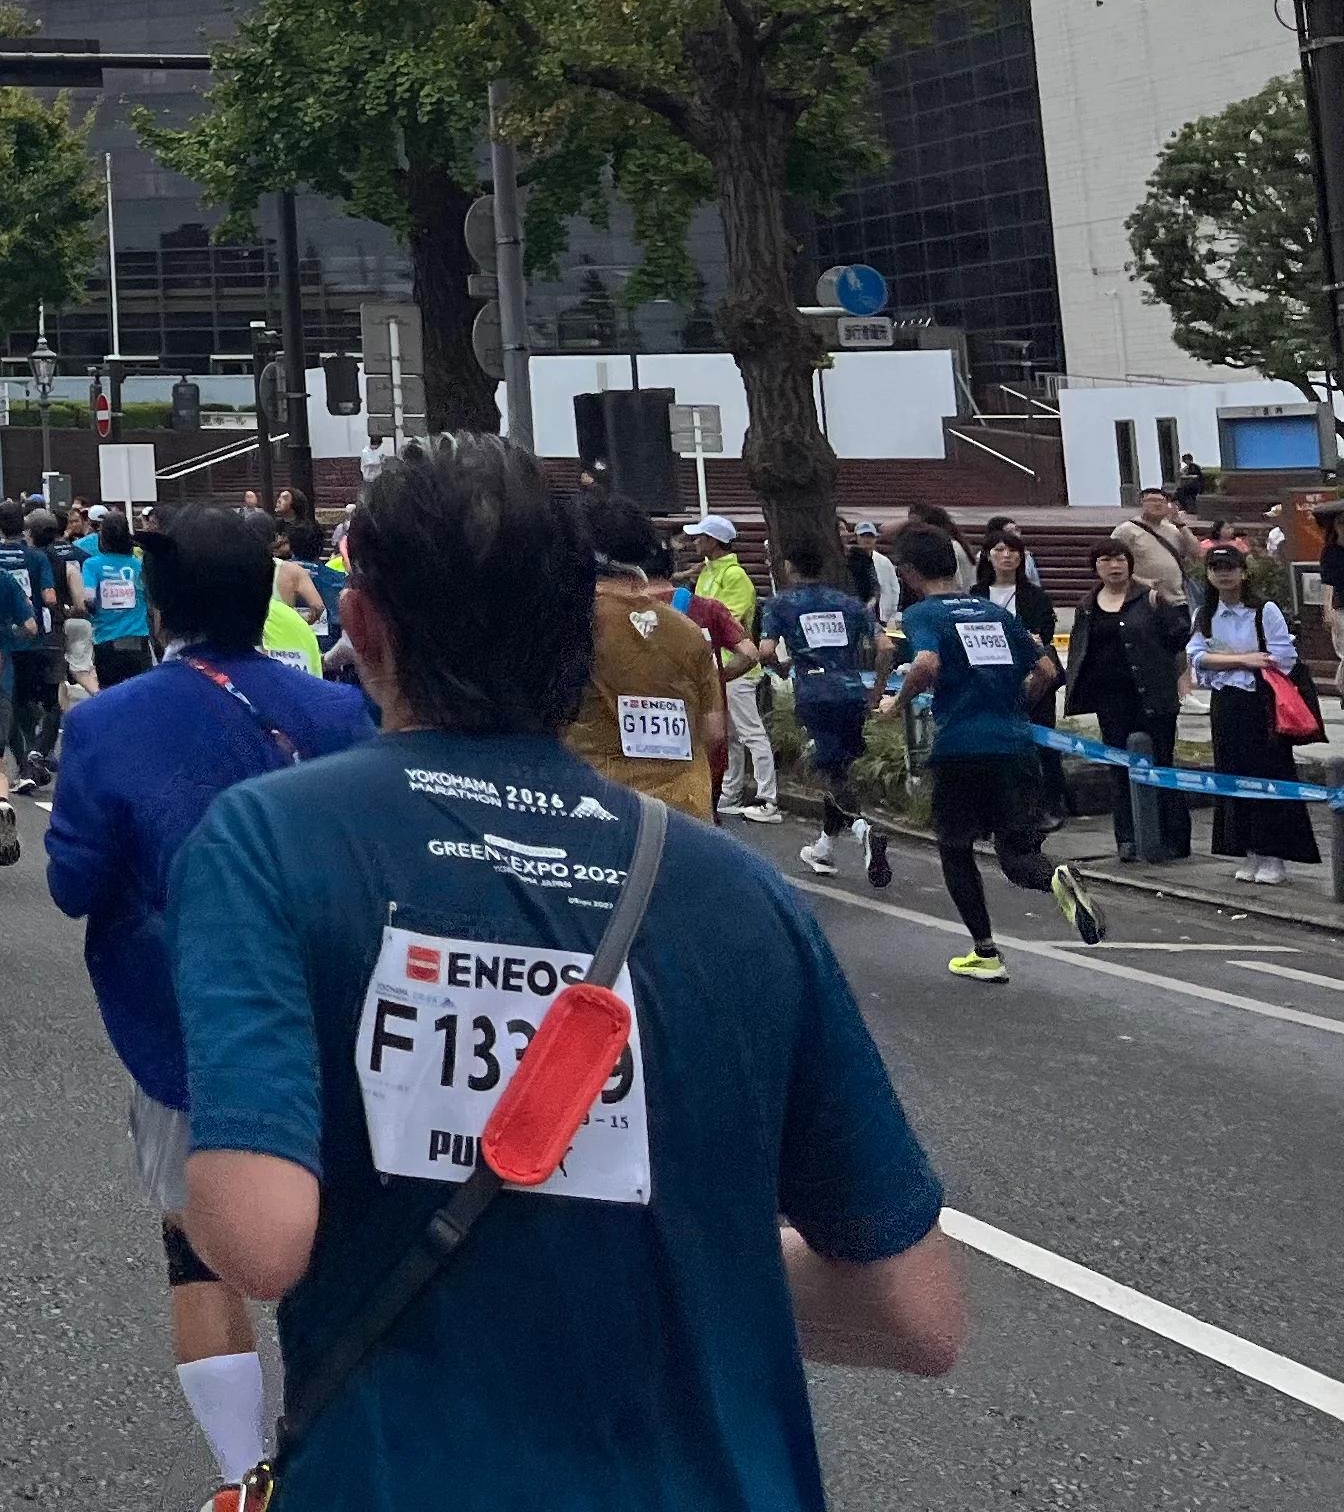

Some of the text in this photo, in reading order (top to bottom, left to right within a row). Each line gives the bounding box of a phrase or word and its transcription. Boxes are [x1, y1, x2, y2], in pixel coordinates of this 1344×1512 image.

[640, 699, 679, 711] ENEOS
[623, 714, 686, 736] G15167
[404, 768, 500, 798] YOKOHAMA
[409, 781, 565, 809] MARATHON 2026
[447, 952, 586, 996] ENEOS
[369, 998, 635, 1104] F1339
[428, 1129, 484, 1167] PU
